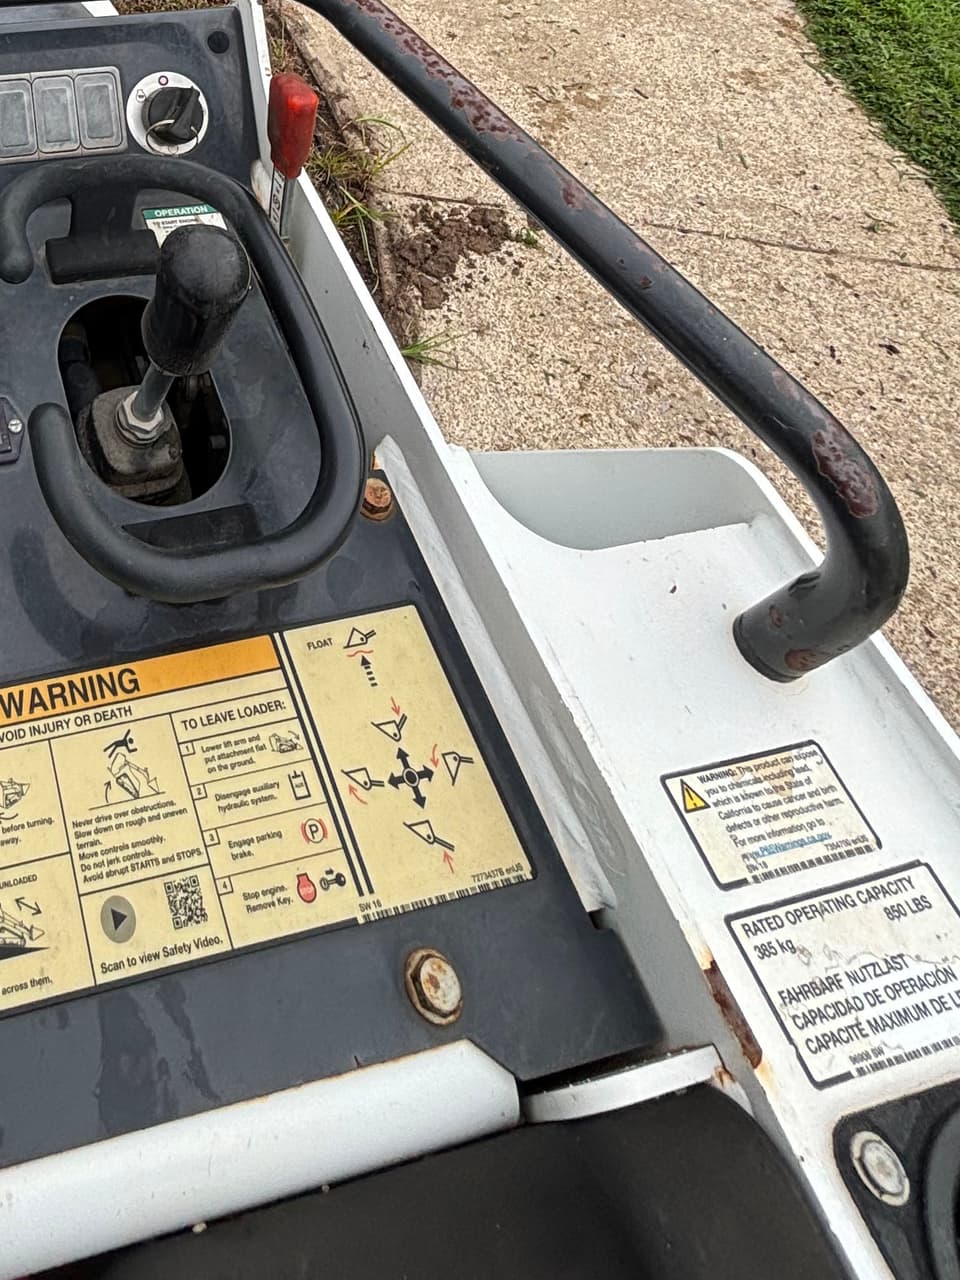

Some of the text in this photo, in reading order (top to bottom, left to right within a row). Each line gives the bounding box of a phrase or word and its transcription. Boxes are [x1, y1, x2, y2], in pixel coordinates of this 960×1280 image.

[154, 204, 208, 217] OPERATION
[307, 638, 333, 650] FLOAT
[28, 718, 71, 737] INJURY
[74, 714, 92, 727] OR
[93, 705, 133, 723] DEATH
[180, 700, 286, 731] TO LEAVE LOADER:
[1, 823, 25, 834] before
[26, 817, 55, 829] turning.
[0, 837, 21, 847] away.
[227, 830, 283, 849] Engage parking
[230, 850, 254, 861] brake.
[242, 891, 260, 901] Stop
[261, 885, 288, 897] engine.
[245, 896, 294, 914] Remove Key.
[741, 875, 915, 938] RATED OPERATING CAPACITY
[883, 895, 932, 921] 850 LBS
[100, 936, 223, 974] Scan to view Safety Video.
[753, 939, 797, 960] 385 kg
[844, 953, 909, 986] NUTZLAST
[1, 982, 29, 996] across
[29, 976, 53, 989] them.
[788, 996, 865, 1031] CAPACIDAD
[863, 988, 886, 1008] DE
[866, 1001, 933, 1035] MAXIMUM
[929, 995, 952, 1014] DE
